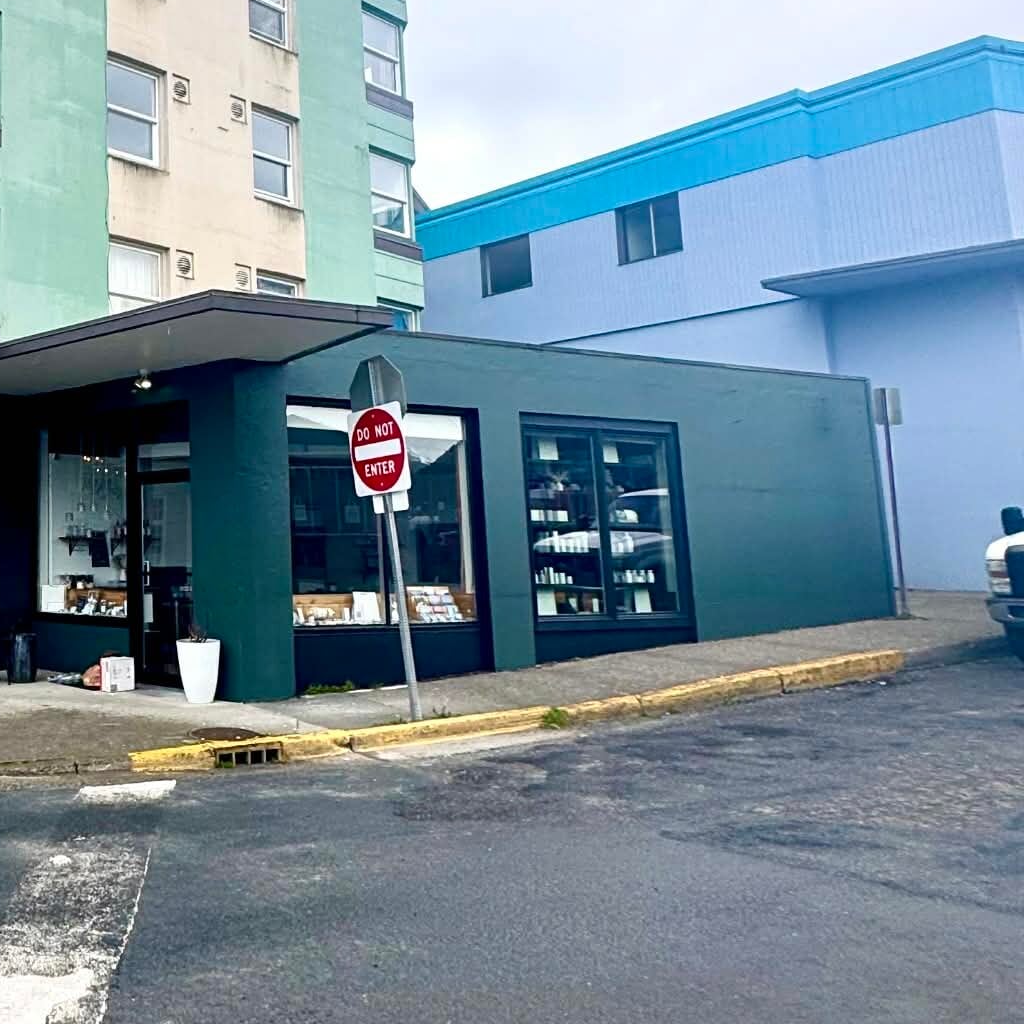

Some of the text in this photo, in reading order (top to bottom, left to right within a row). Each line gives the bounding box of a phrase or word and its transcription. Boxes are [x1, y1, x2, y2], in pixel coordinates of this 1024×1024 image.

[356, 421, 394, 441] DO NOT
[364, 460, 395, 477] ENTER
